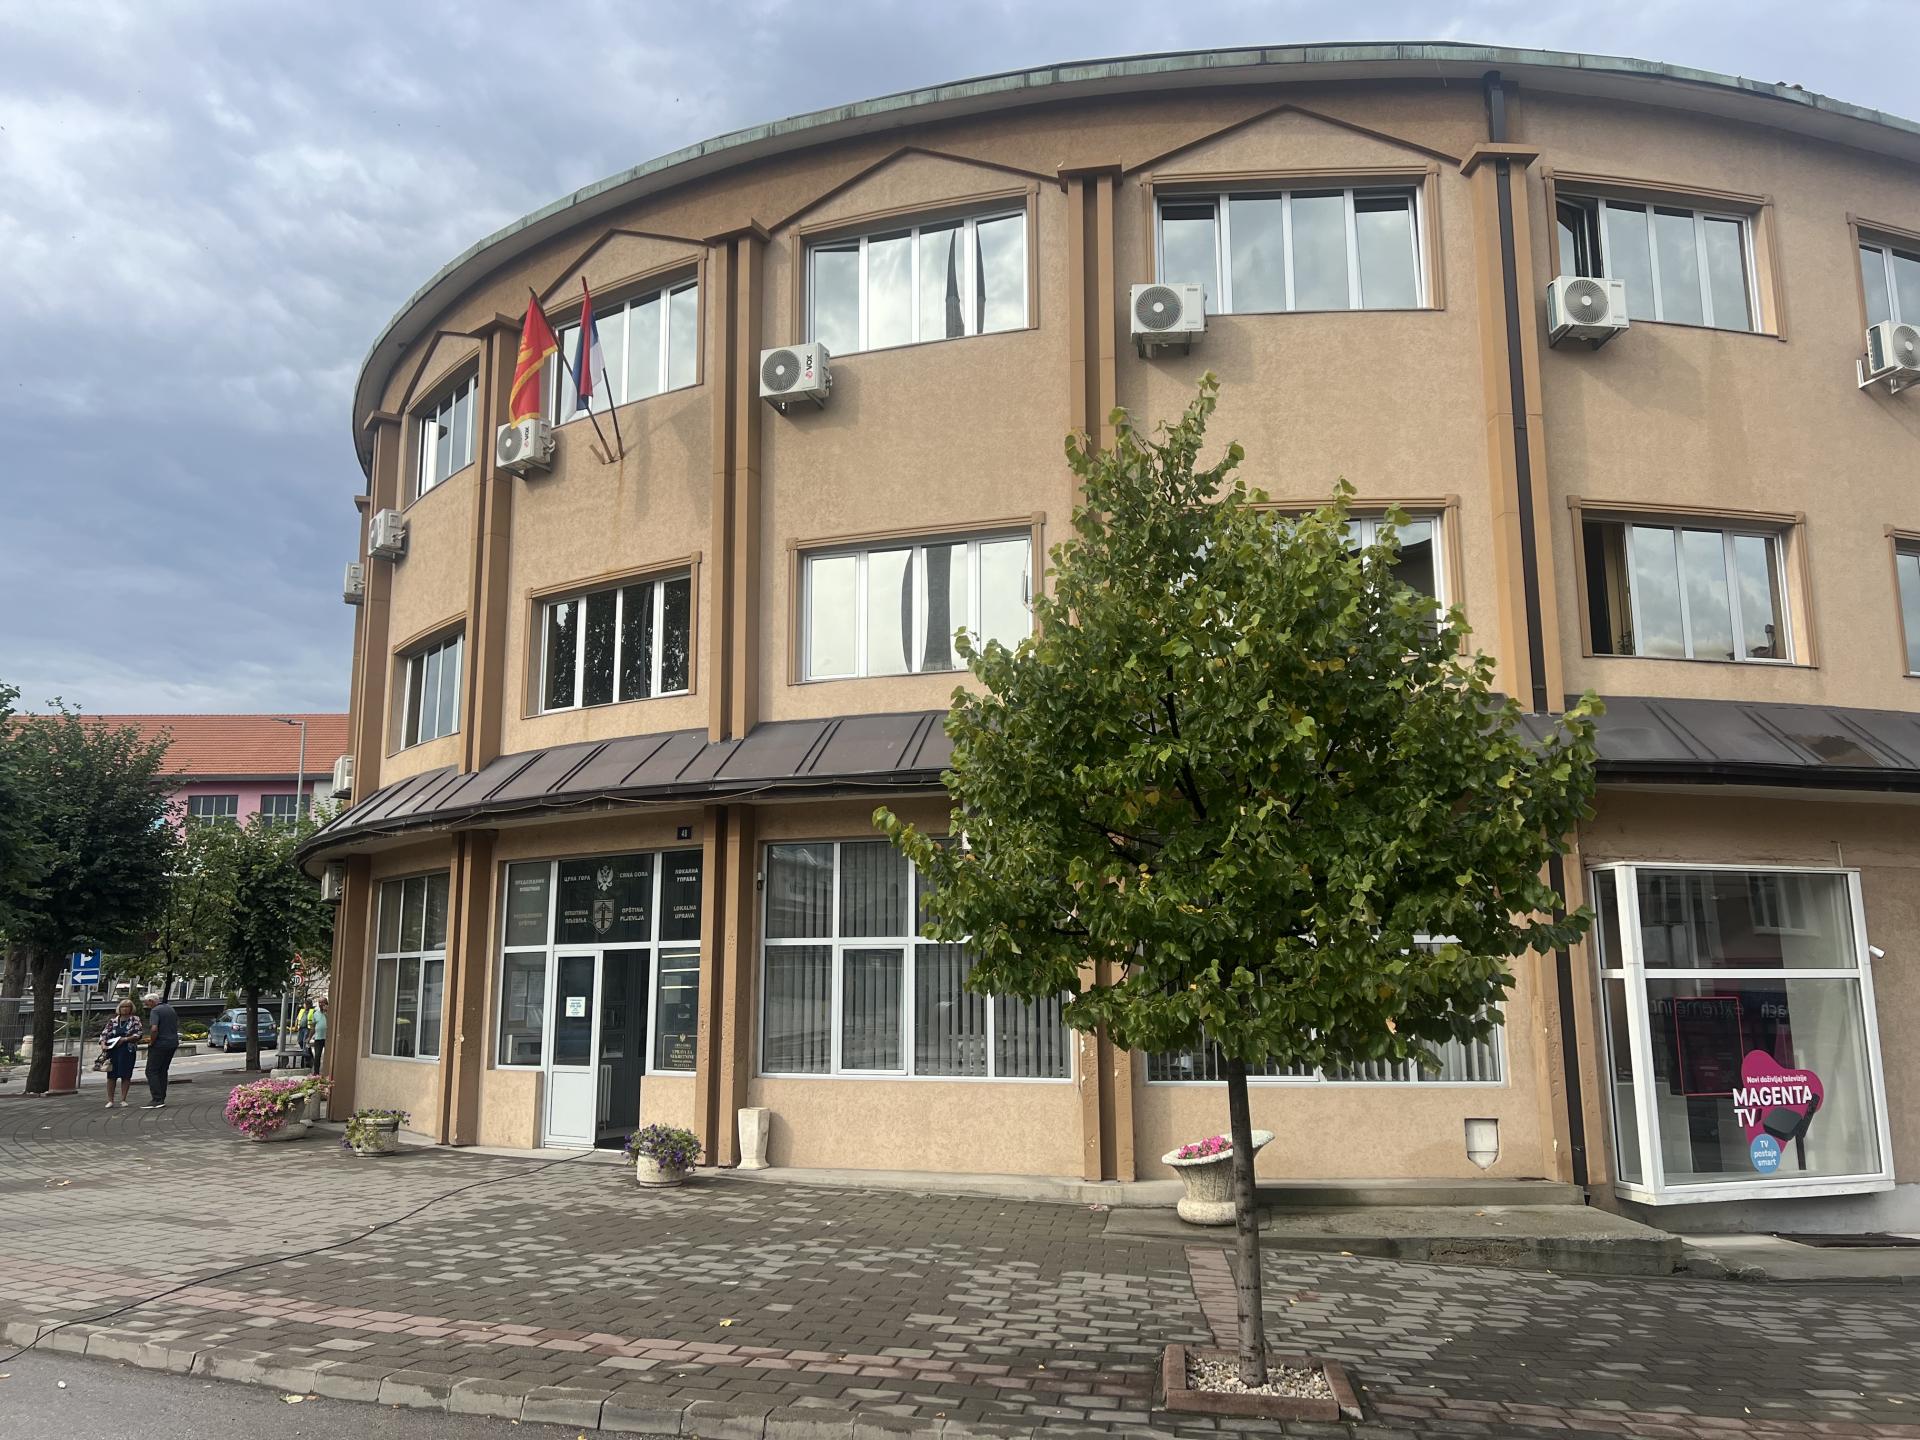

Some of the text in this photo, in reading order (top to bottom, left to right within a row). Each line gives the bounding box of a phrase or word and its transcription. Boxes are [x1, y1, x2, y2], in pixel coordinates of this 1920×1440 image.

[673, 904, 697, 912] LOKALNA
[619, 914, 645, 922] PLJEVLJA
[80, 949, 93, 967] P
[1746, 1074, 1807, 1084] Novi doživljaj televizije
[1732, 1086, 1812, 1107] MAGENTA
[1734, 1108, 1756, 1127] TV
[1760, 1140, 1769, 1148] TV
[1753, 1150, 1777, 1159] postaje
[1758, 1158, 1777, 1166] smart
